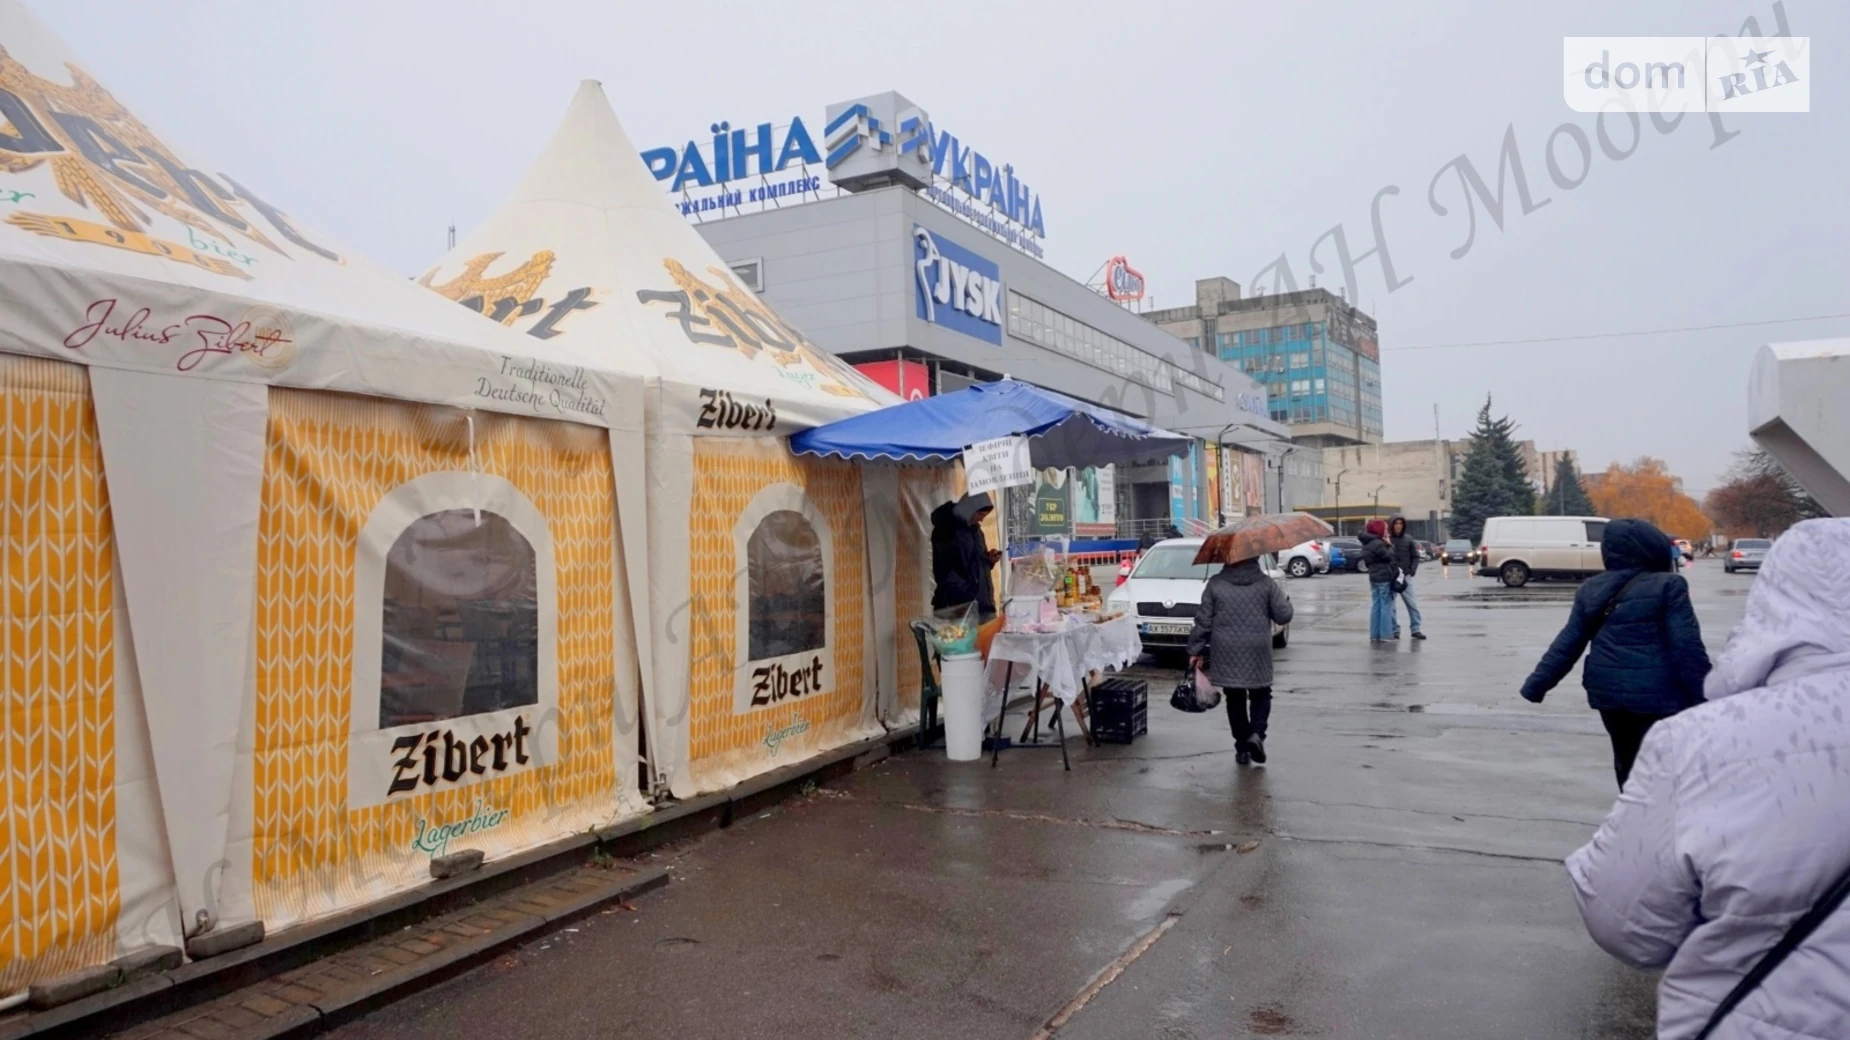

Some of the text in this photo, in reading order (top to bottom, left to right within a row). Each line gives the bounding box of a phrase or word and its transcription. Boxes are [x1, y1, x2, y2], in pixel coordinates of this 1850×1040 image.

[675, 176, 821, 217] ЖАЛЬНИЙ КОМПЛЕКС
[928, 120, 1045, 239] УКРАЇНА
[186, 224, 259, 267] bier
[934, 255, 1002, 326] JYSK
[63, 298, 293, 372] Julius Zibert
[474, 376, 606, 416] Deutsche Qualität
[500, 355, 589, 390] Traditionelle
[750, 655, 823, 707] Zibert
[386, 715, 531, 797] Zibert
[411, 799, 509, 859] Lagerbier
